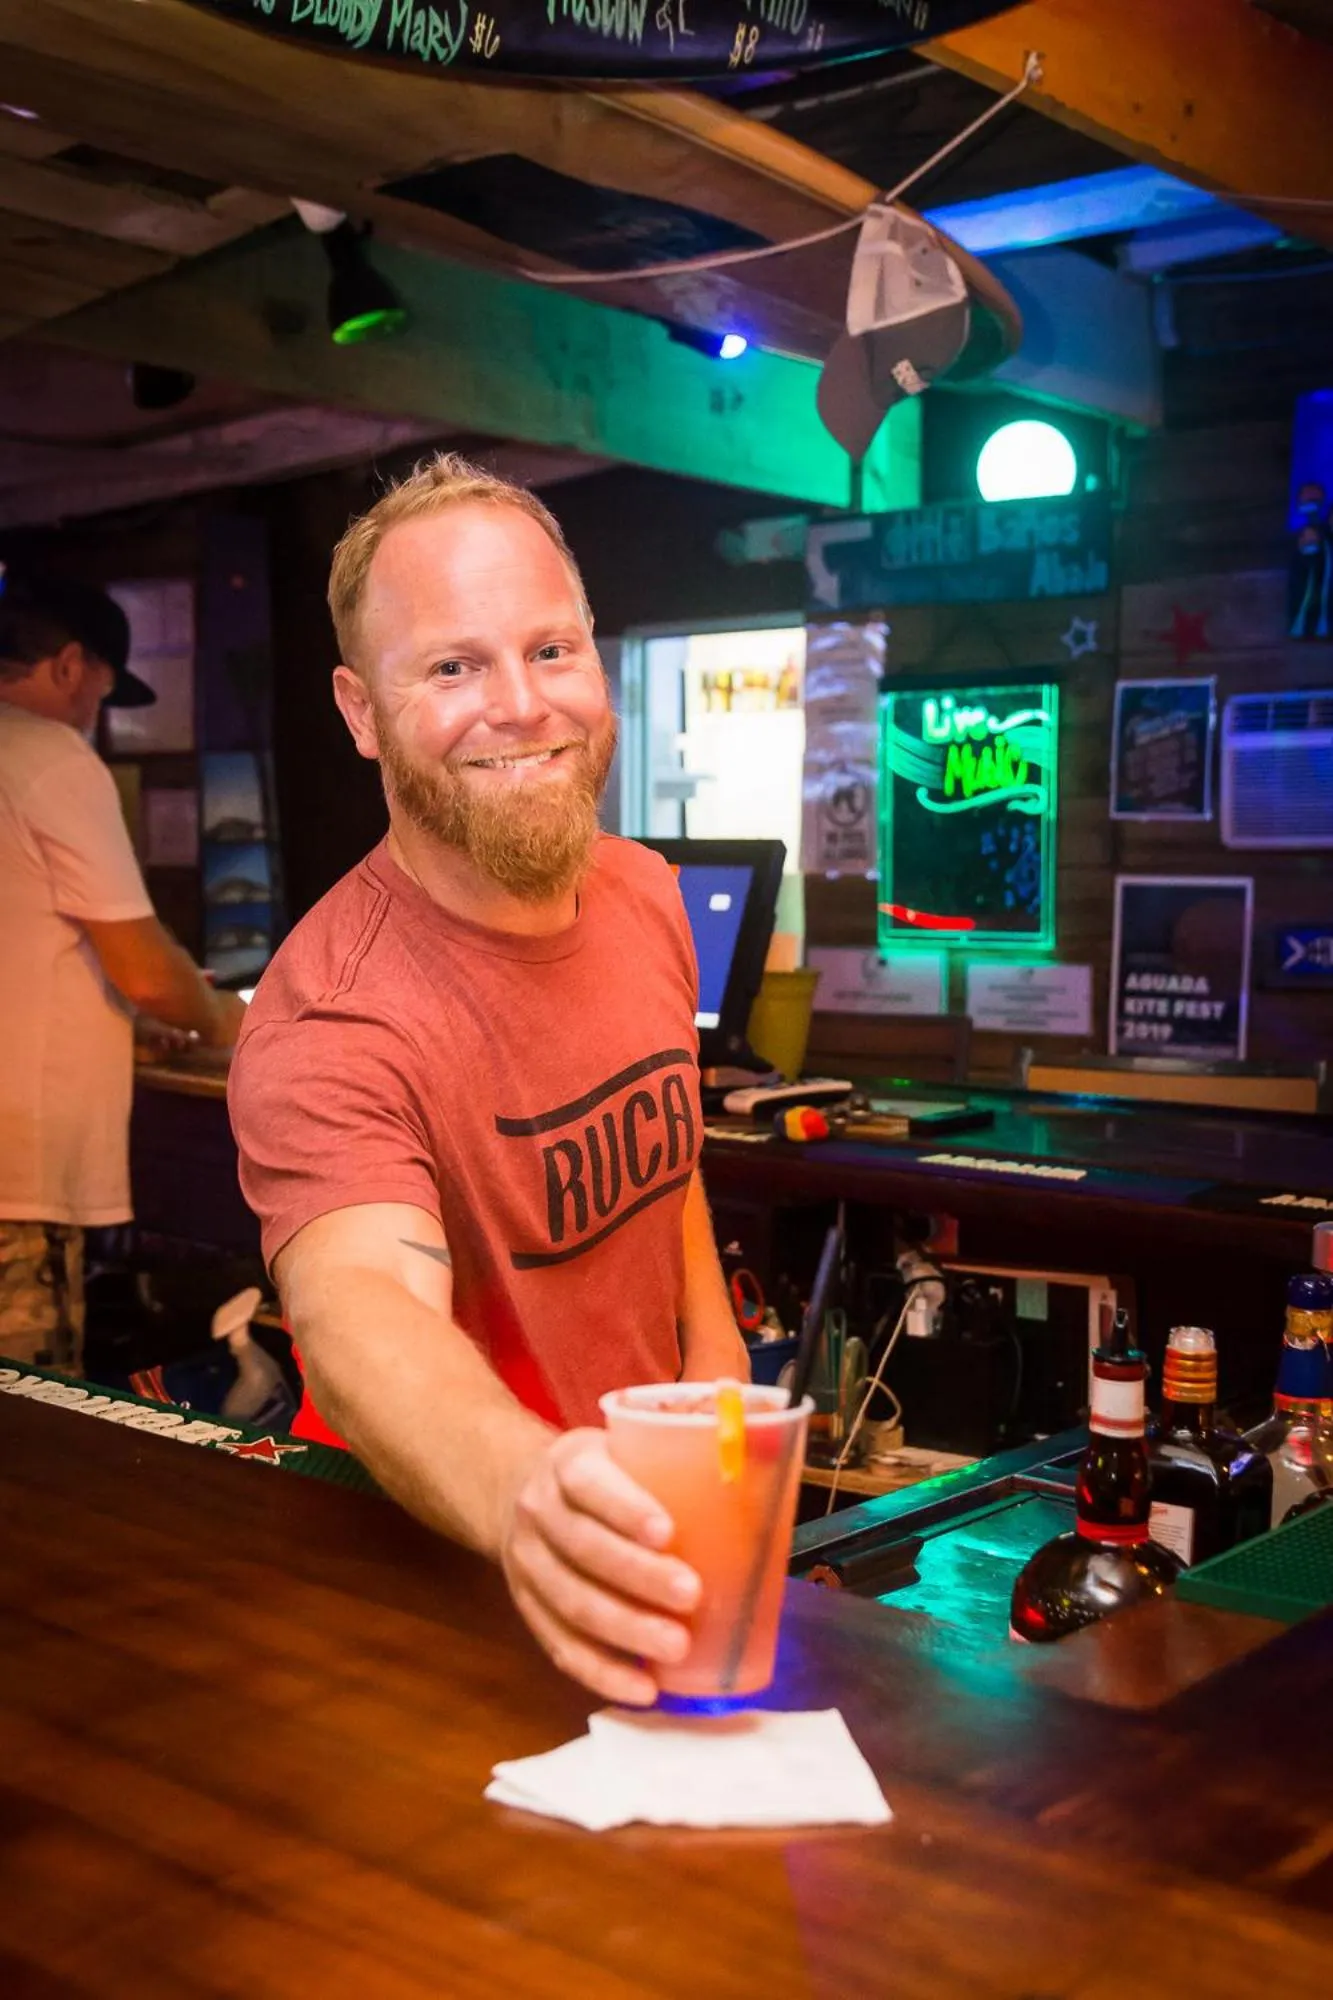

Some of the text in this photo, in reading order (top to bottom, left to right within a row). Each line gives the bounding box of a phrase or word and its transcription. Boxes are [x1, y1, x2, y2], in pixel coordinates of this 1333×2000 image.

[468, 12, 500, 59] $6
[728, 22, 759, 69] $8
[1123, 997, 1225, 1020] KITE FEST
[1122, 1021, 1173, 1040] 2019
